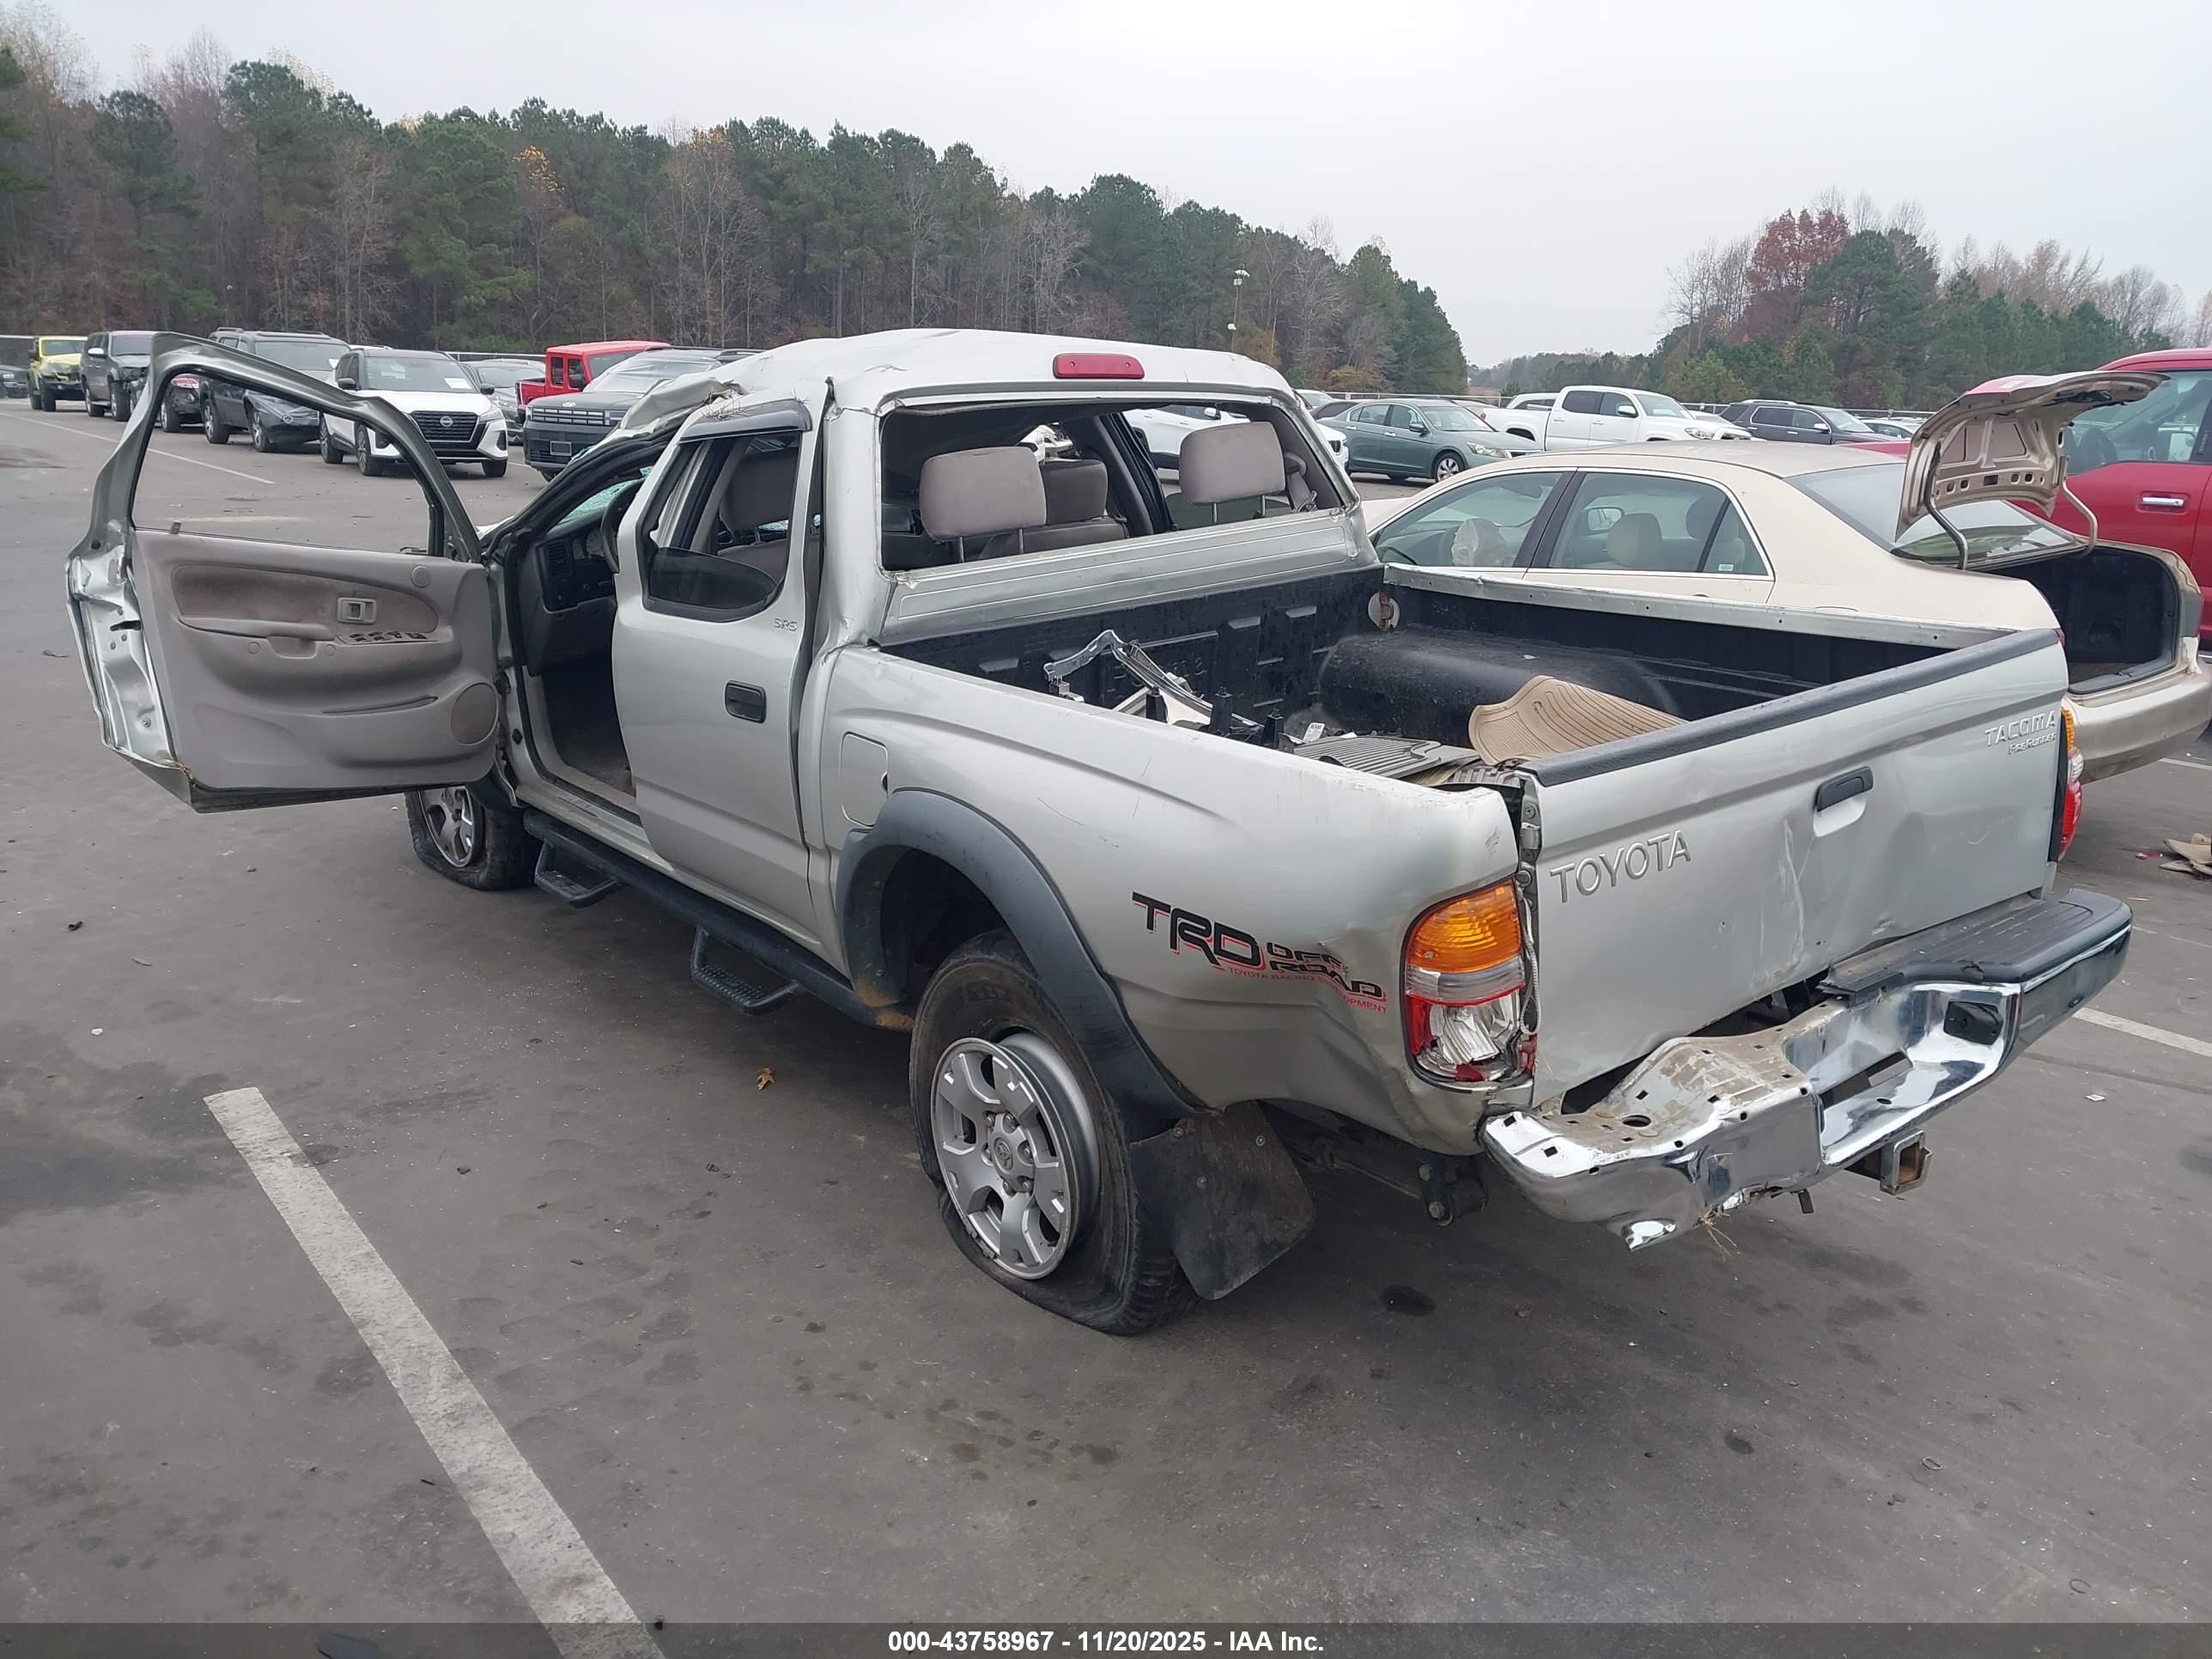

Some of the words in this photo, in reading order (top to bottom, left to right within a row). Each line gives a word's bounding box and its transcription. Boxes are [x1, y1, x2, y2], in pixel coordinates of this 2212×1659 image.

[1984, 709, 2056, 747] TACOMA
[1548, 830, 1692, 903] TOYOTA
[1132, 890, 1266, 971] TRD
[1228, 967, 1268, 980] TOYOTA
[1266, 941, 1345, 970] OFF
[1269, 960, 1386, 1001] ROAD
